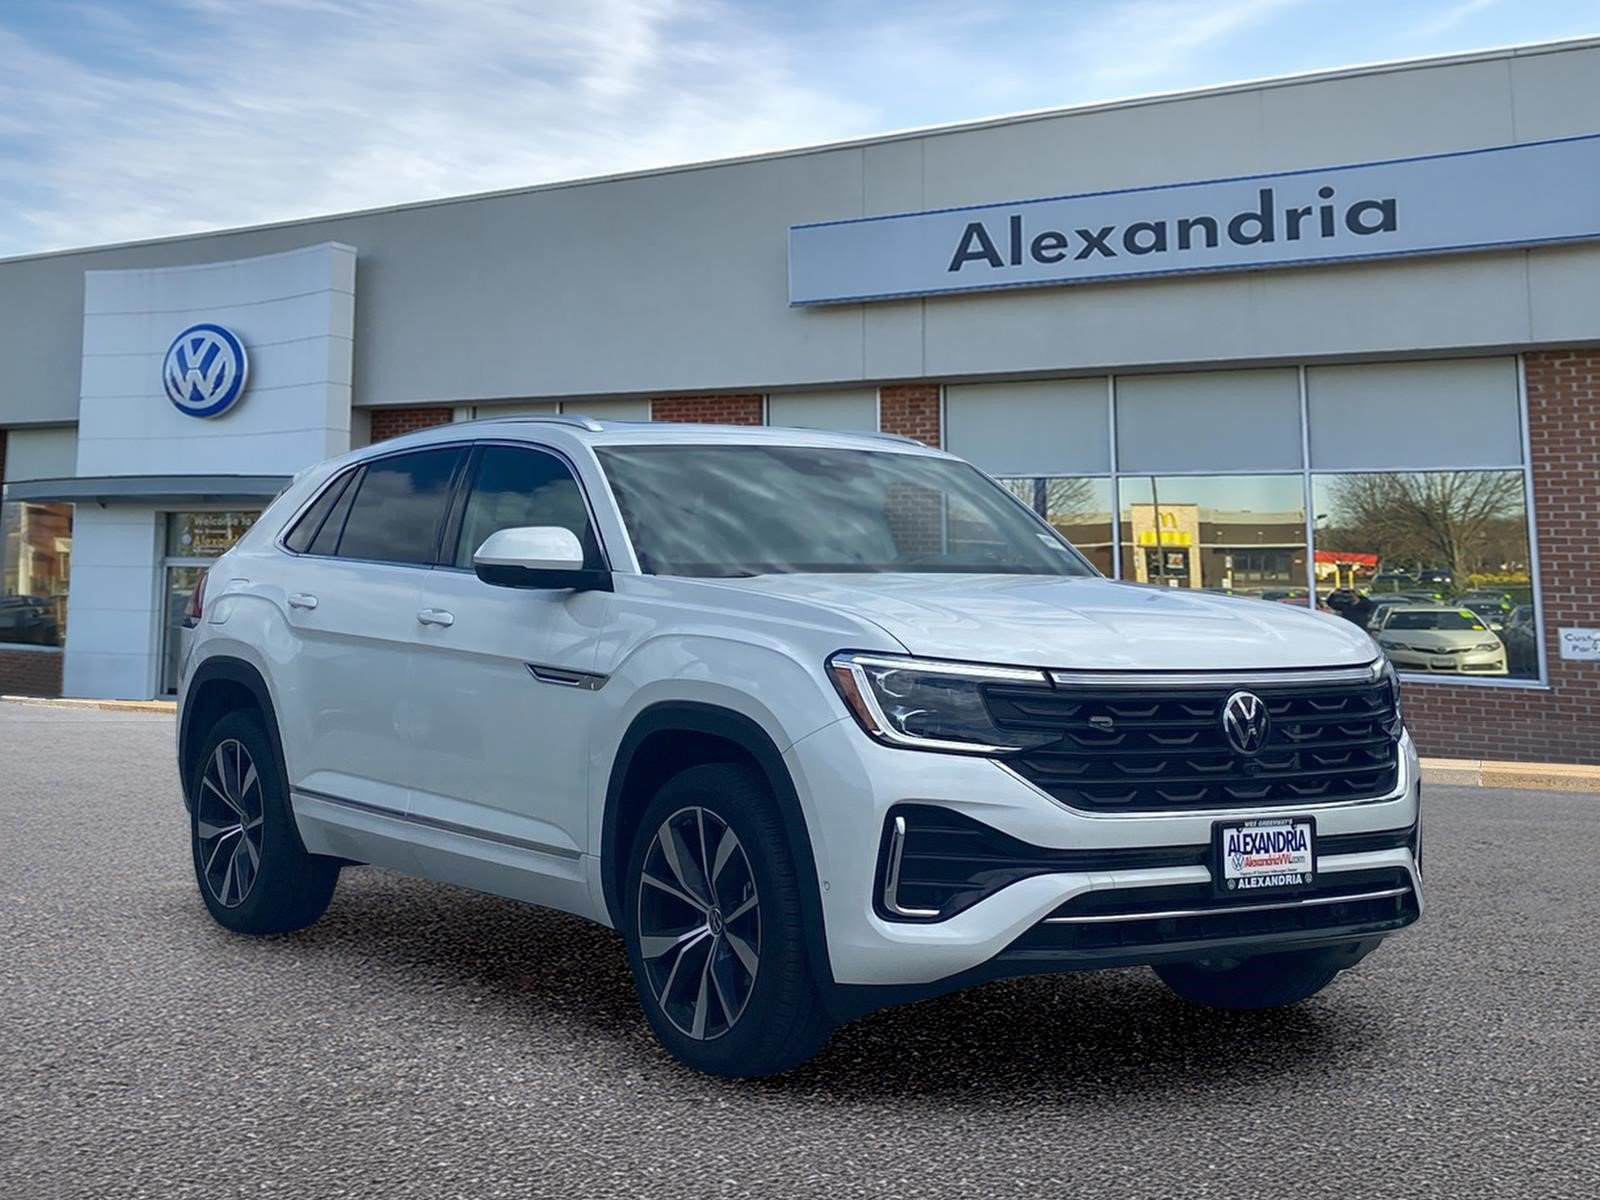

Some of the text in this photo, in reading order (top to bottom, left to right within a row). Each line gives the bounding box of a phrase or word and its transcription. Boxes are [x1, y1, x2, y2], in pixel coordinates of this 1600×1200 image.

[947, 185, 1398, 273] Alexandria
[165, 325, 243, 413] VW
[1228, 829, 1307, 856] ALEXANDRIA
[1238, 874, 1302, 889] ALEXANDRIA
